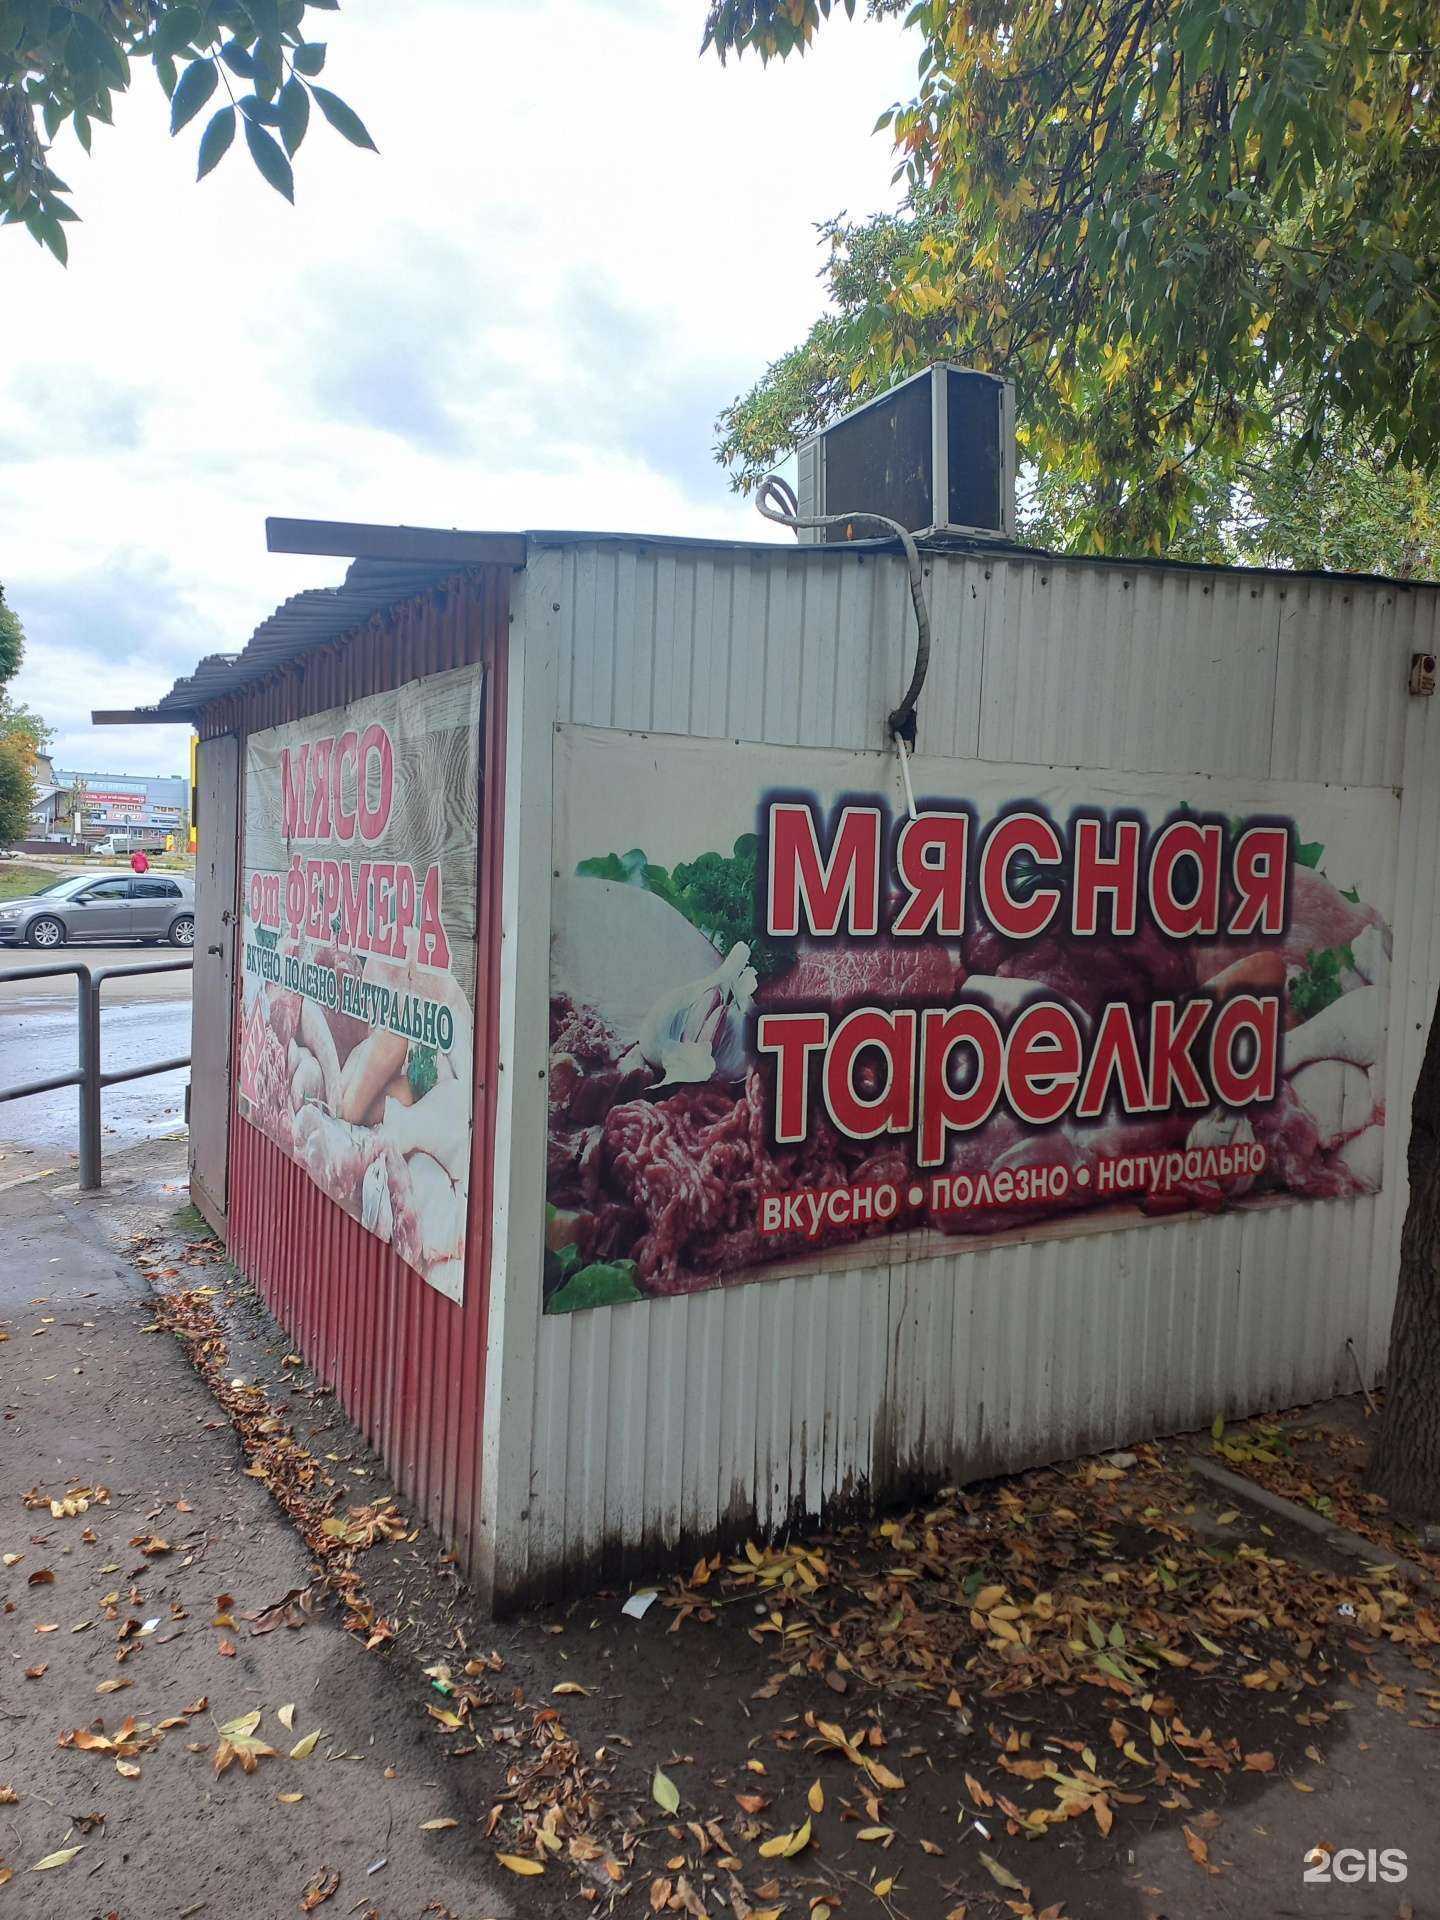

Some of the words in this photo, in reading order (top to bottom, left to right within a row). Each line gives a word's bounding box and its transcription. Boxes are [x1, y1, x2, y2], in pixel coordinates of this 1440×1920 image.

[280, 723, 393, 845] МЯСО
[285, 853, 452, 972] ФЕРМЕРА
[342, 975, 453, 1052] НАТУРАЛЬНО
